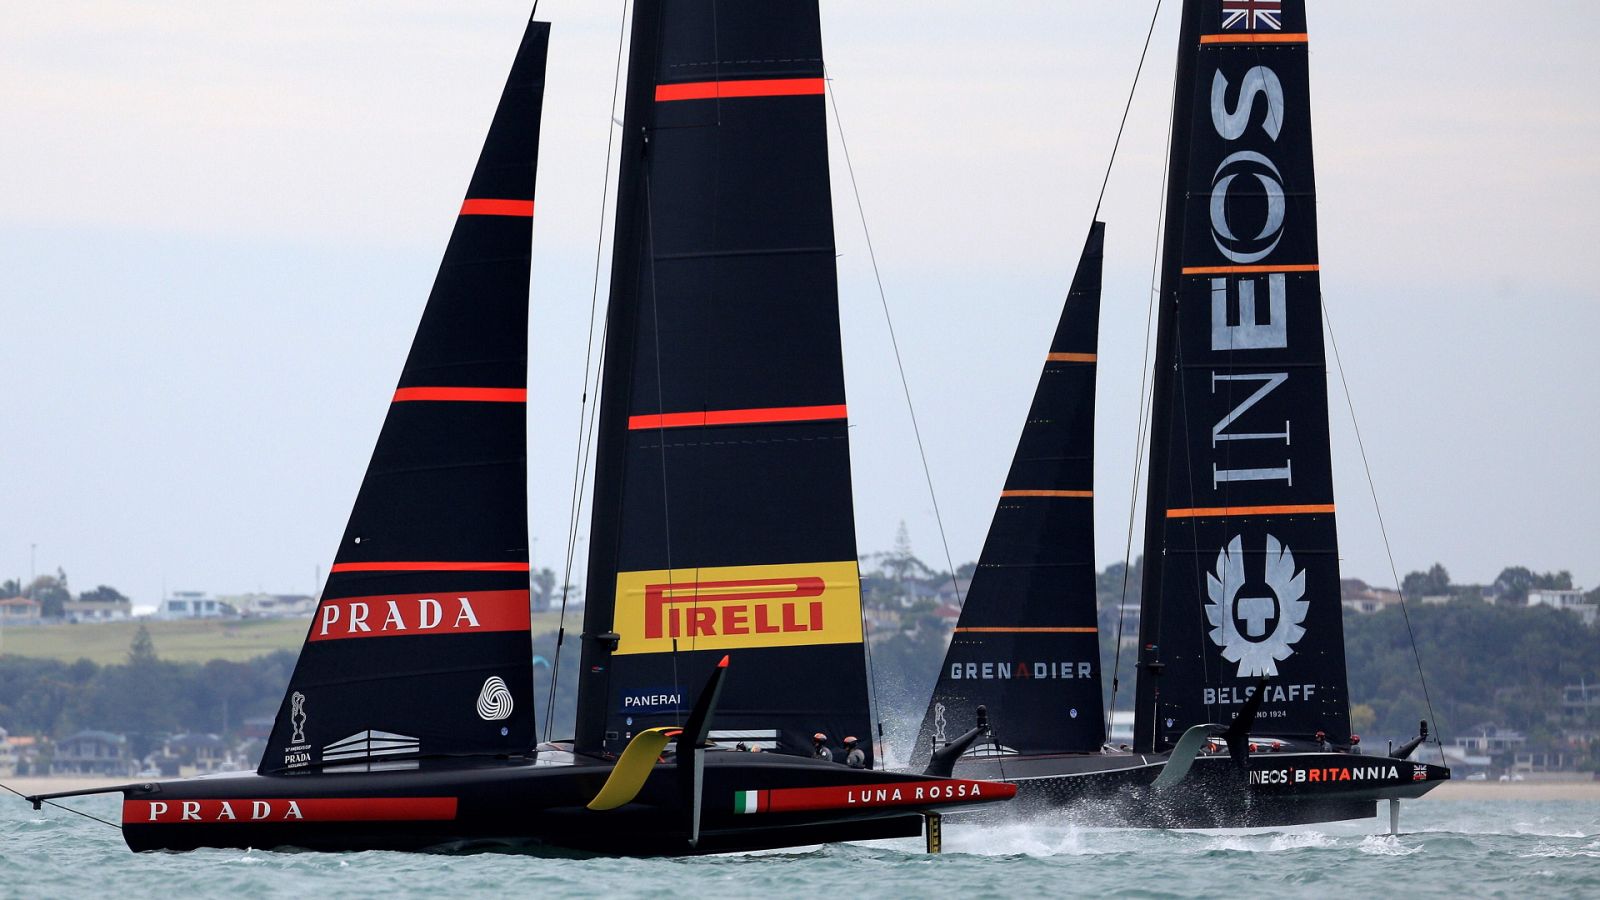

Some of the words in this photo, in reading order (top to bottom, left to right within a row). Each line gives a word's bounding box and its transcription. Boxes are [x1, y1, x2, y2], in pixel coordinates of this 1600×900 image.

[1209, 65, 1292, 490] INEOS
[319, 597, 481, 636] PRADA
[644, 576, 826, 639] PIRELLI
[950, 662, 1092, 680] GRENADIER
[625, 694, 681, 707] PANERAI
[1269, 710, 1287, 718] 1924
[284, 752, 311, 764] PRADA
[1249, 769, 1288, 785] INEOS
[1295, 766, 1399, 783] BRITANNIA
[848, 787, 902, 803] LUNA
[915, 782, 982, 799] ROSSA
[149, 799, 304, 821] PRADA
